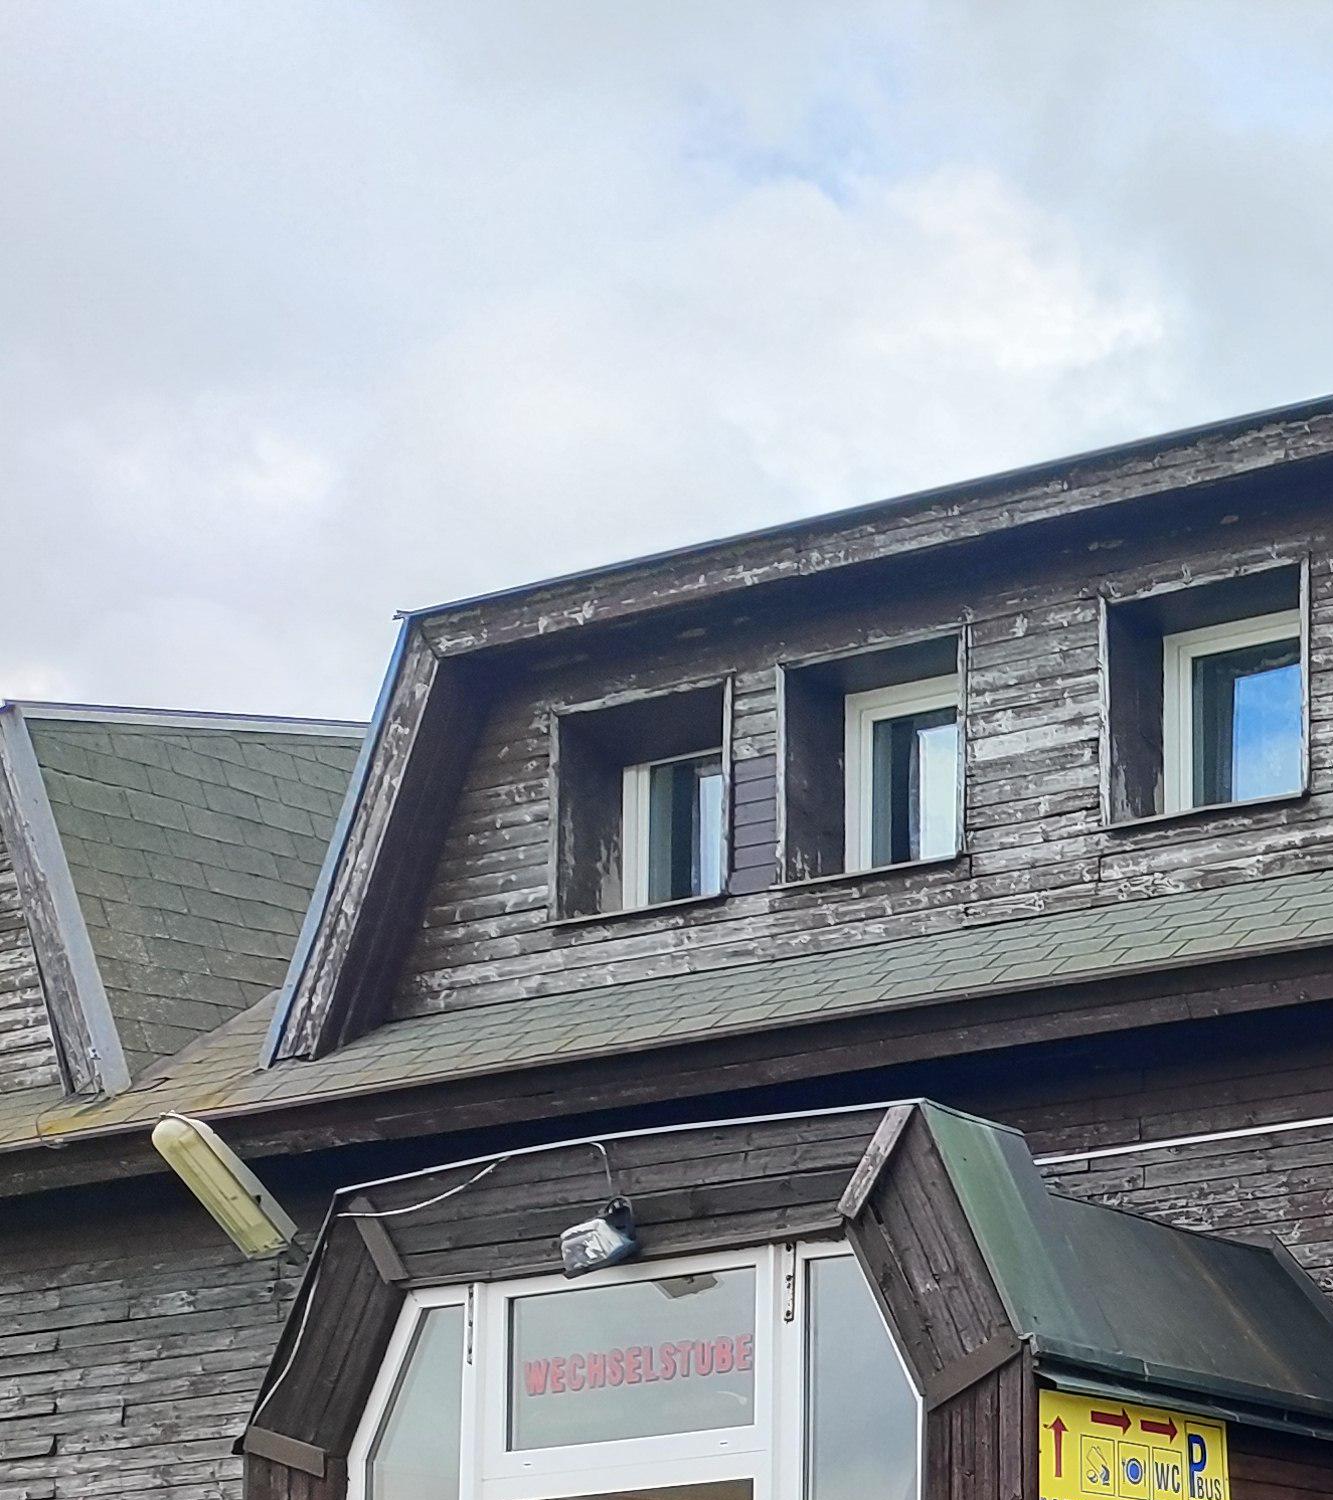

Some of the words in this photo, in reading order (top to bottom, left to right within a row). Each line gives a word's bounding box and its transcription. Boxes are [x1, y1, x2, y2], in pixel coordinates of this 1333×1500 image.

[524, 1333, 754, 1397] WECHSELSTUBE
[1154, 1461, 1181, 1494] WC
[1187, 1432, 1208, 1499] P
